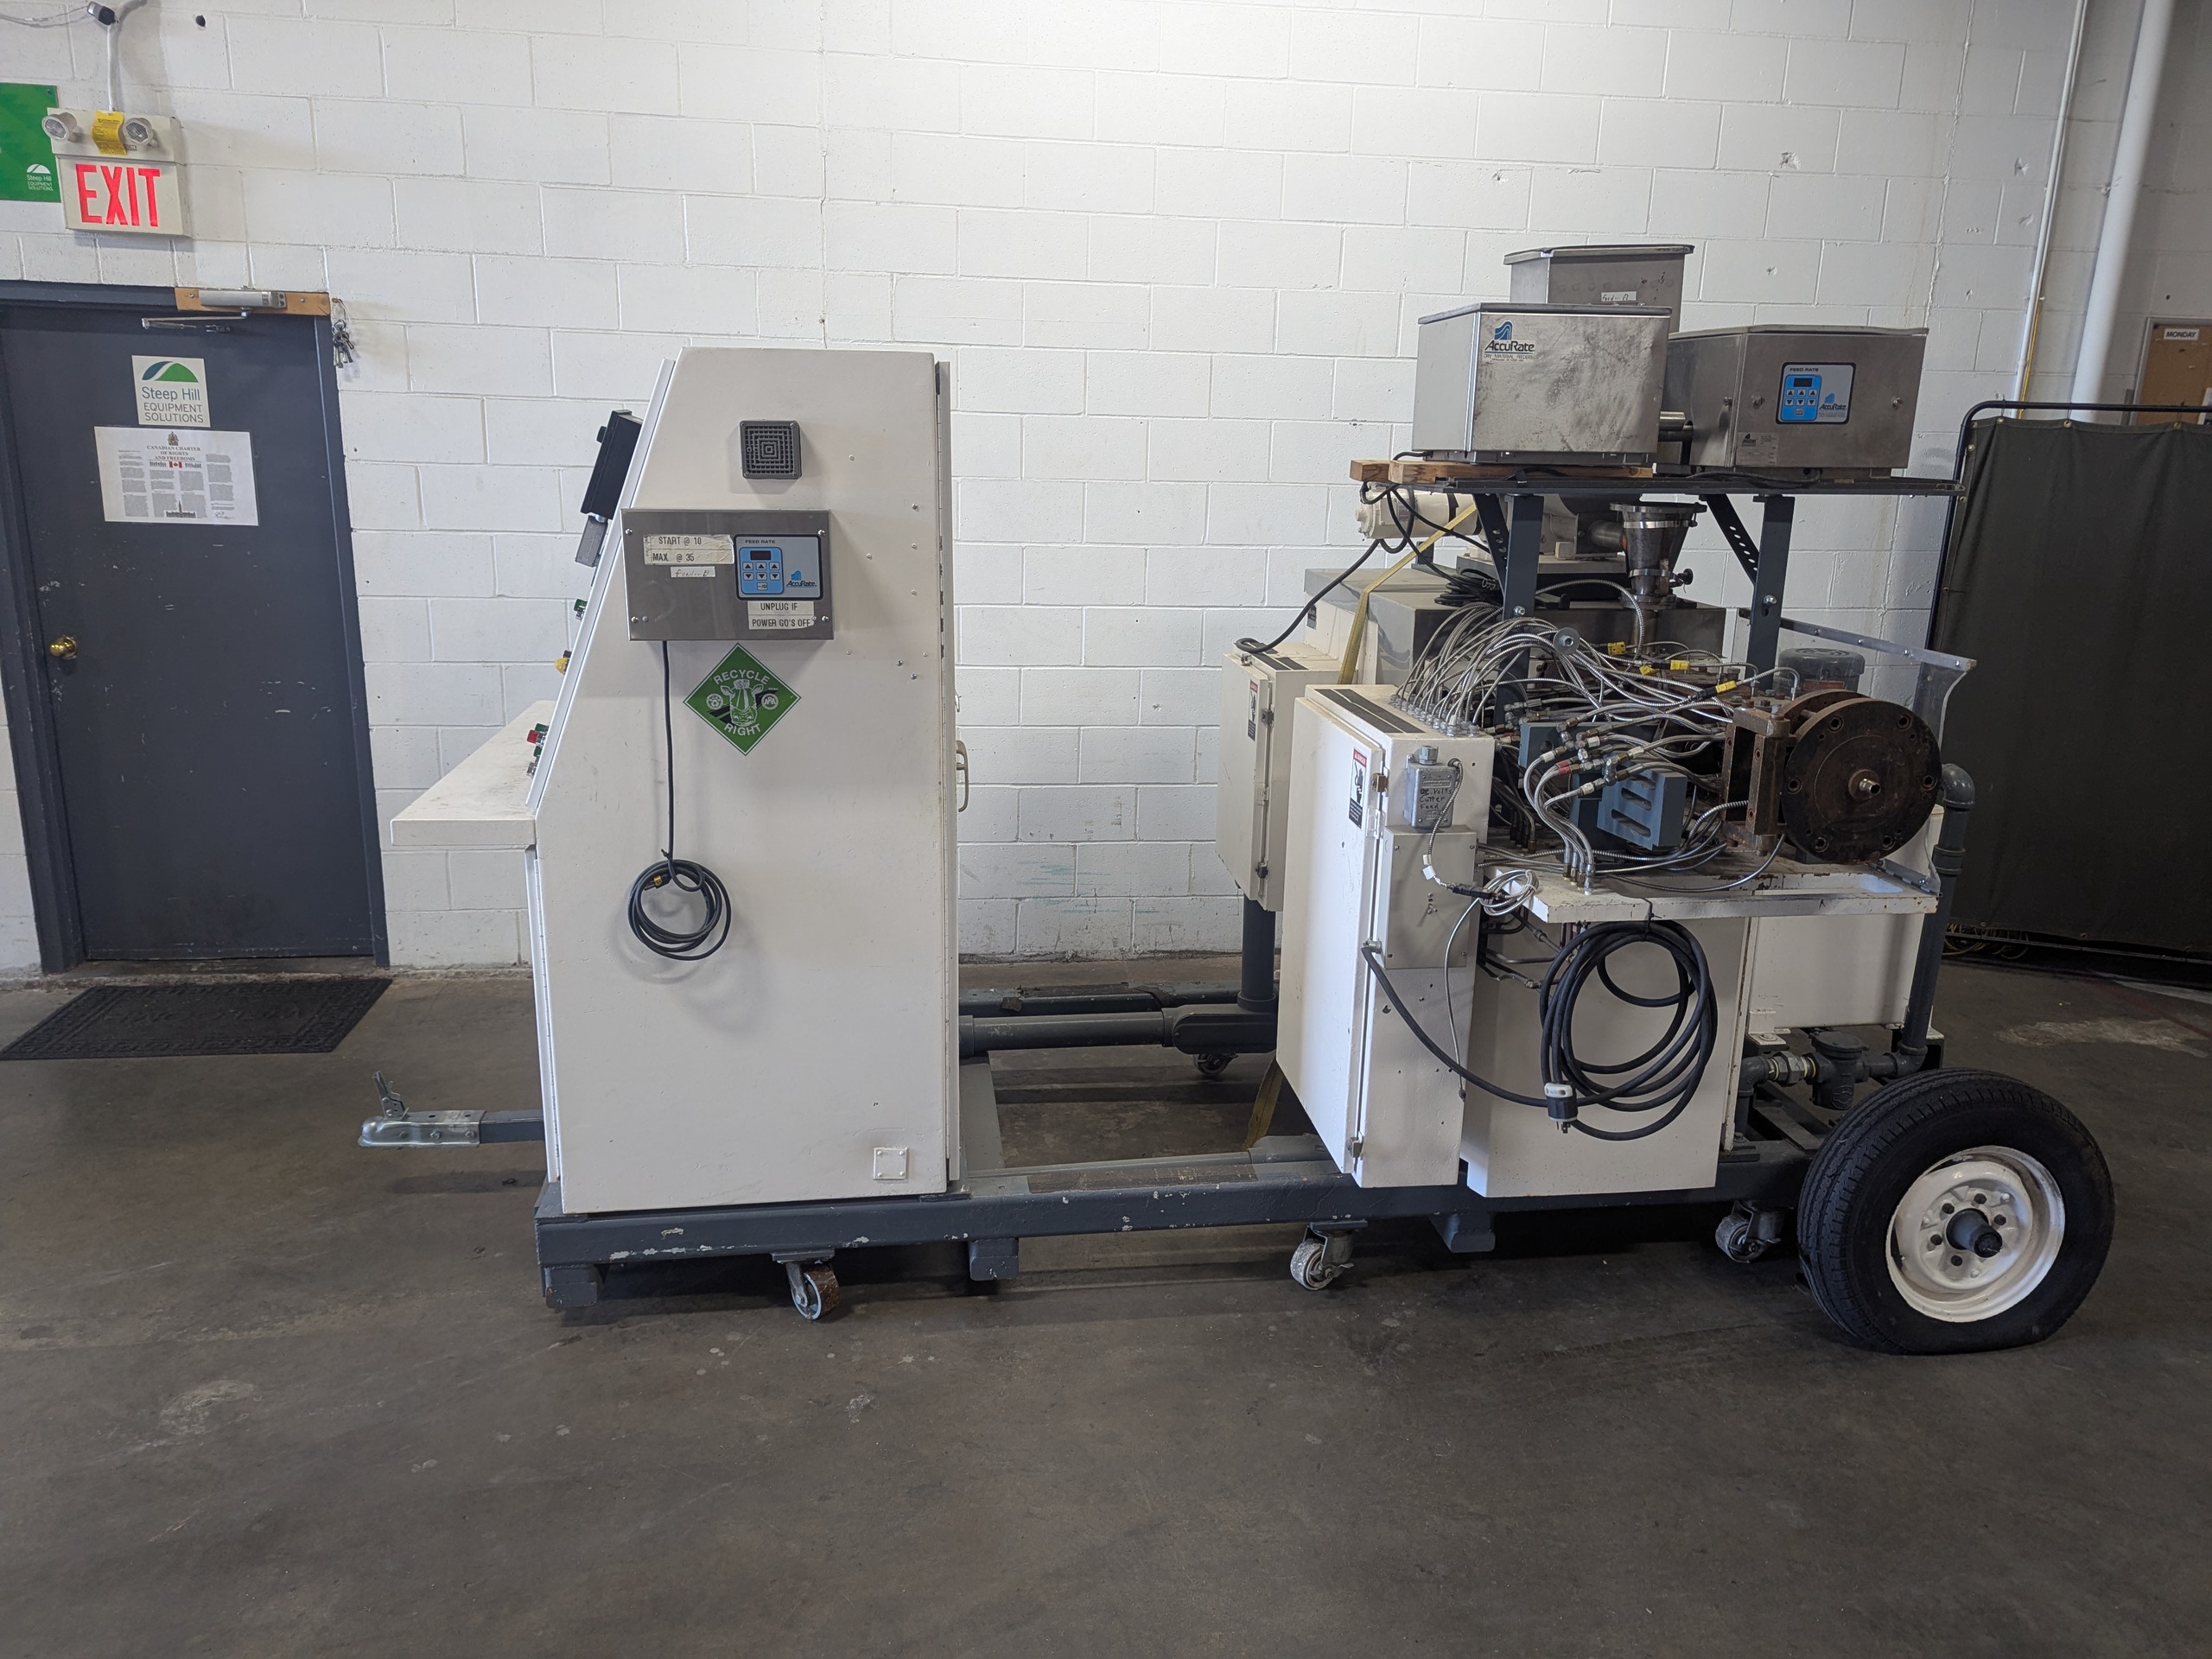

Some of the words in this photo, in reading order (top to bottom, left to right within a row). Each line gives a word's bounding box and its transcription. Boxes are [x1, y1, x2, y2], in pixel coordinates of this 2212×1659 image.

[76, 162, 161, 227] EXIT
[1484, 340, 1535, 352] AccuRate
[142, 386, 178, 402] Steep
[181, 388, 200, 401] Hill
[143, 402, 203, 413] EQUIPMENT
[144, 412, 204, 423] SOLUTIONS
[658, 536, 681, 545] START
[683, 537, 690, 546] @
[694, 537, 702, 545] 10
[652, 552, 669, 562] MAX
[676, 553, 683, 563] @
[685, 553, 695, 562] 35
[760, 602, 789, 611] UNPLUG
[791, 602, 798, 611] IF
[752, 619, 777, 627] POWER
[779, 619, 796, 627] GO'S
[798, 619, 810, 627] OFF
[713, 669, 770, 685] RECYCLE
[723, 722, 761, 736] RIGHT
